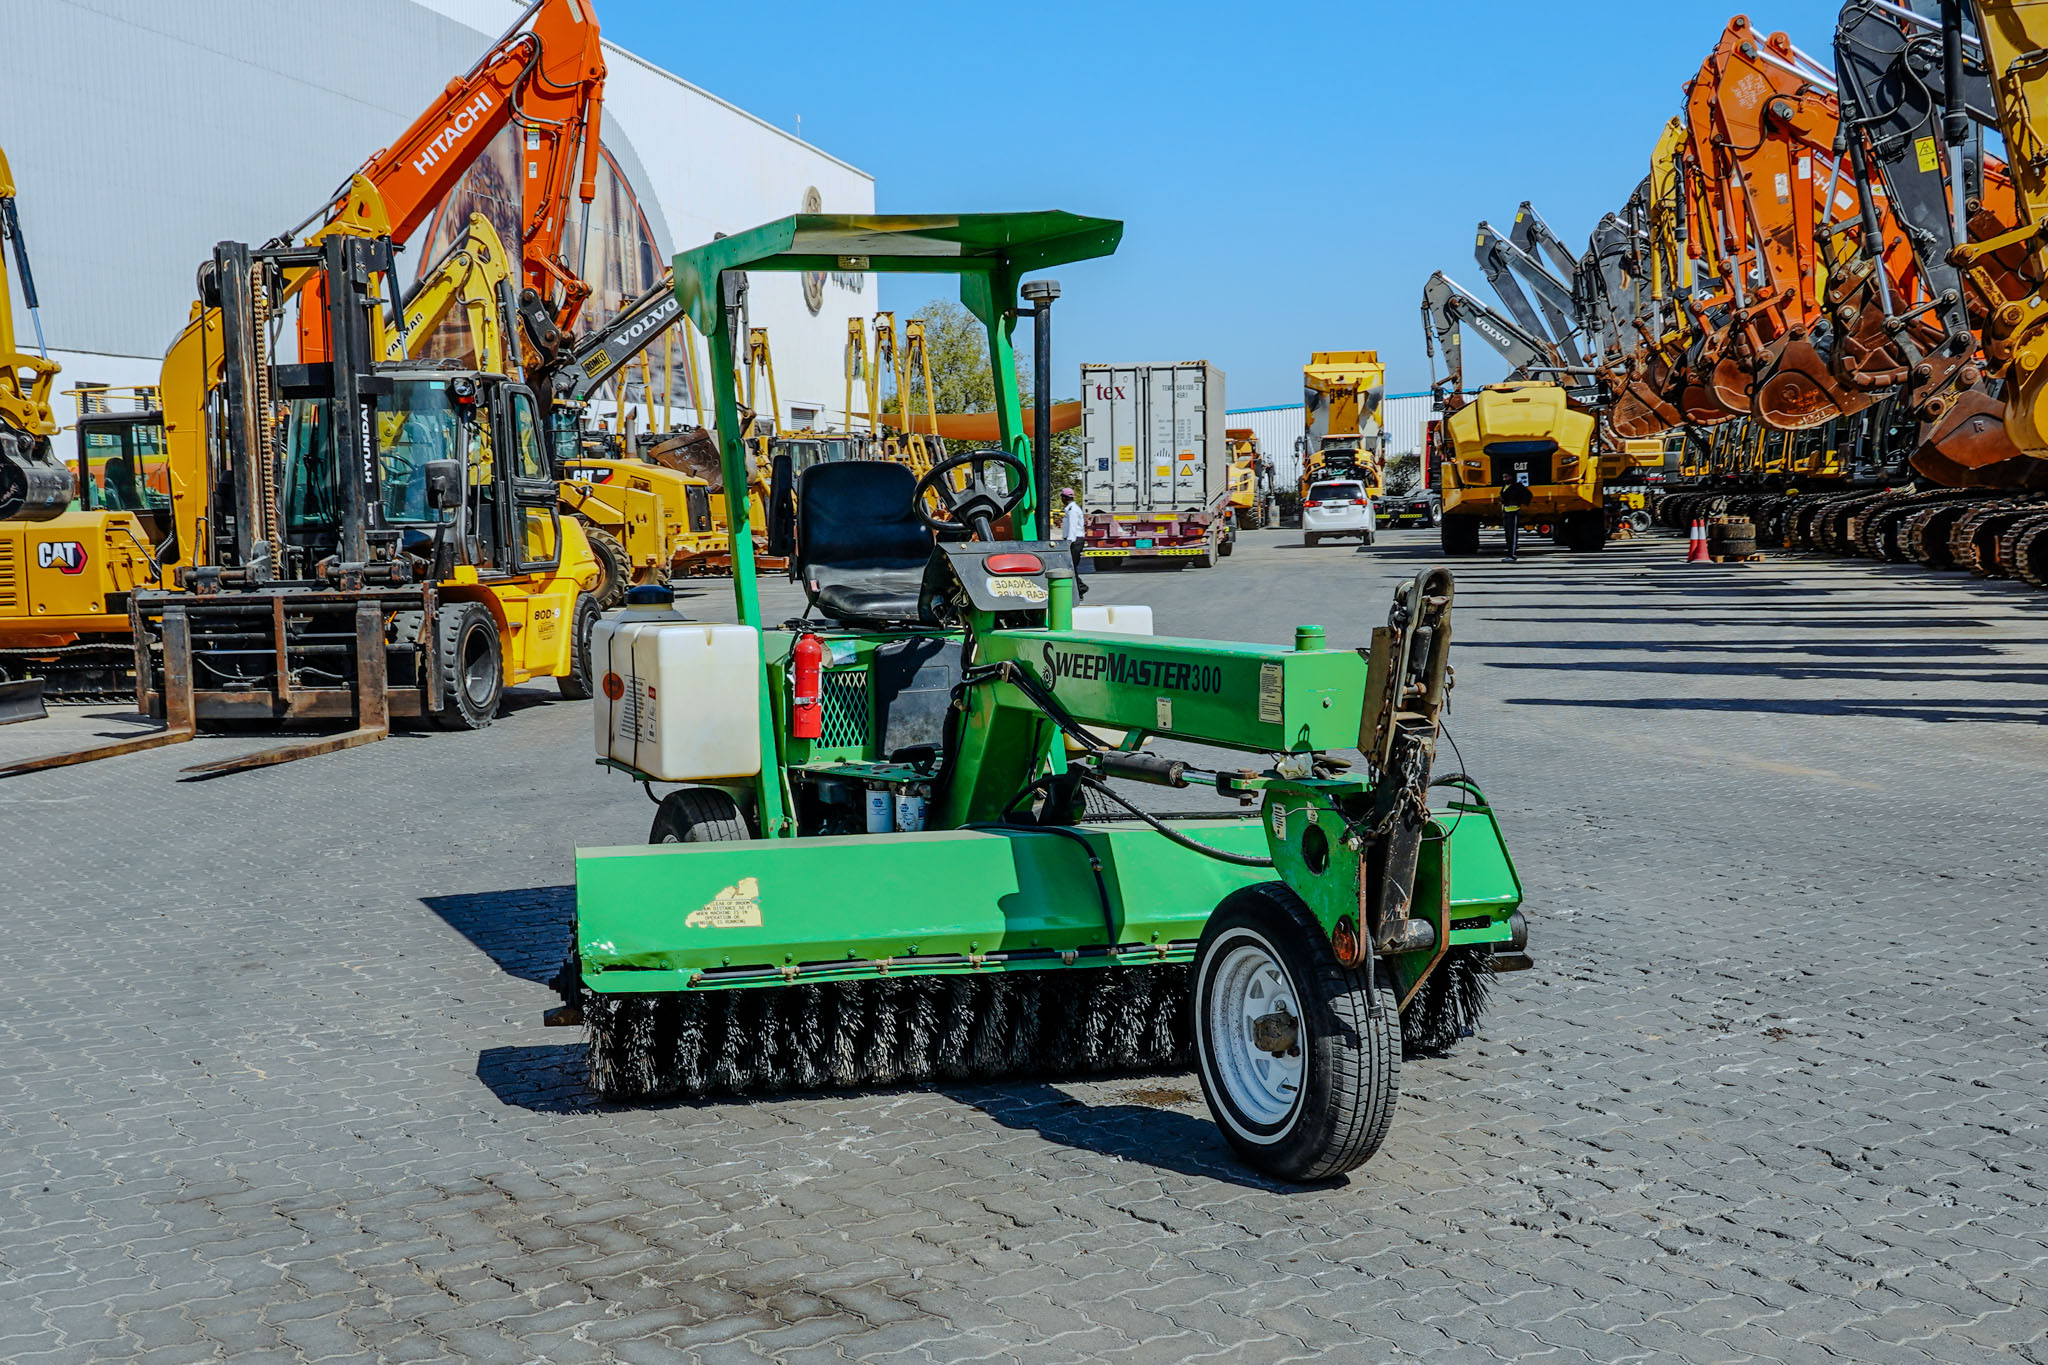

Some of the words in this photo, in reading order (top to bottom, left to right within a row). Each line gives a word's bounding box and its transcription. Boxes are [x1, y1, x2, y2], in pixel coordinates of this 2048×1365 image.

[412, 91, 493, 176] HITACHI
[613, 297, 679, 346] VOLVO
[1475, 317, 1511, 347] VOLVO
[1096, 383, 1126, 401] tex
[360, 403, 373, 483] HYUNDAI
[573, 469, 595, 483] CAT
[1513, 461, 1528, 471] CAT
[38, 542, 77, 568] CAT
[534, 608, 560, 620] 80D-9
